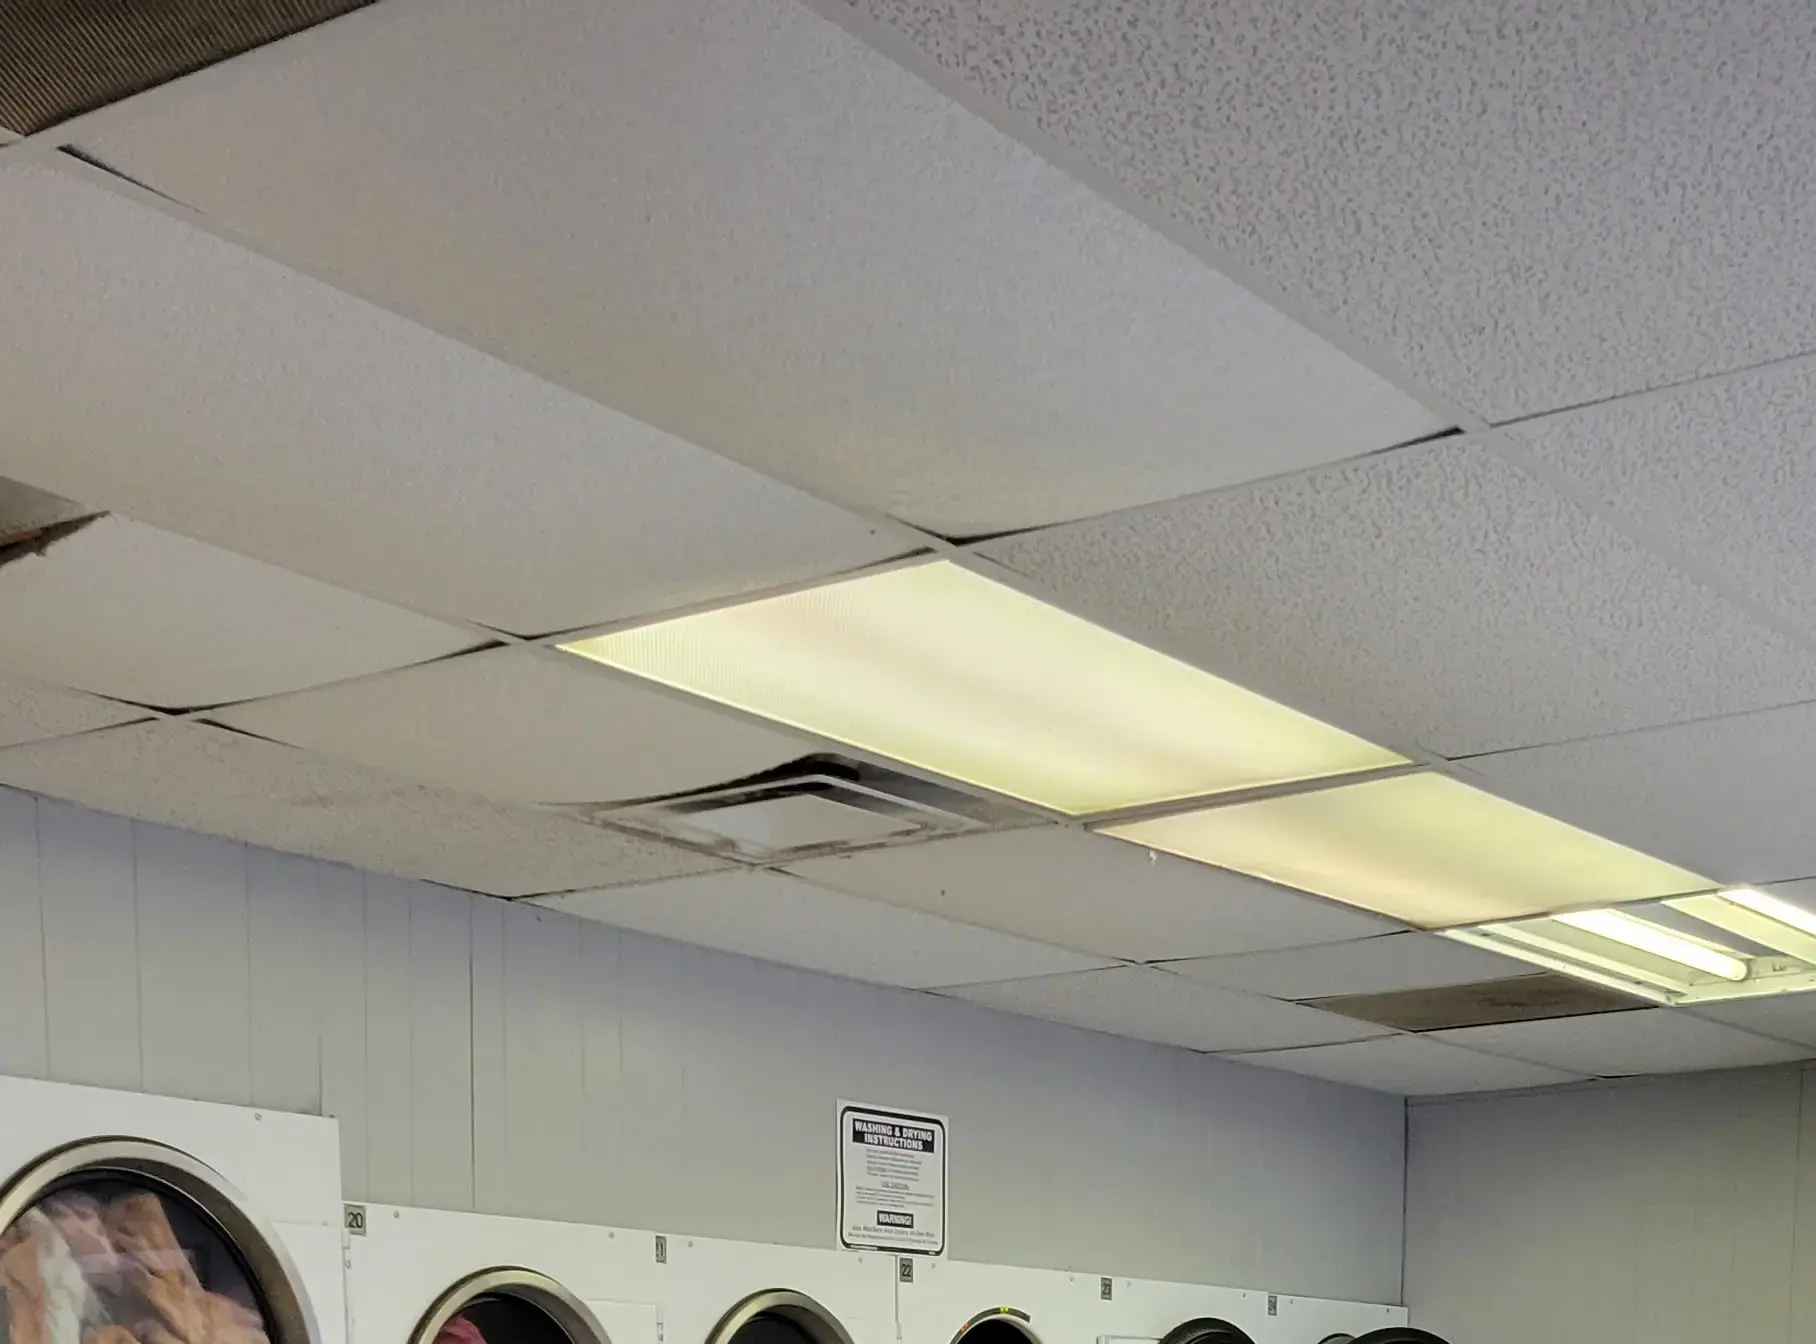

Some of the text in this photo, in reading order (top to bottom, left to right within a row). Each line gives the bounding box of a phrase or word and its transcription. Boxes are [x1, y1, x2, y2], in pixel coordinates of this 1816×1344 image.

[854, 1120, 933, 1142] WASHING & DRYING
[864, 1133, 923, 1150] INSTRUCTIONS
[347, 1211, 364, 1229] 20
[900, 1263, 912, 1278] 22
